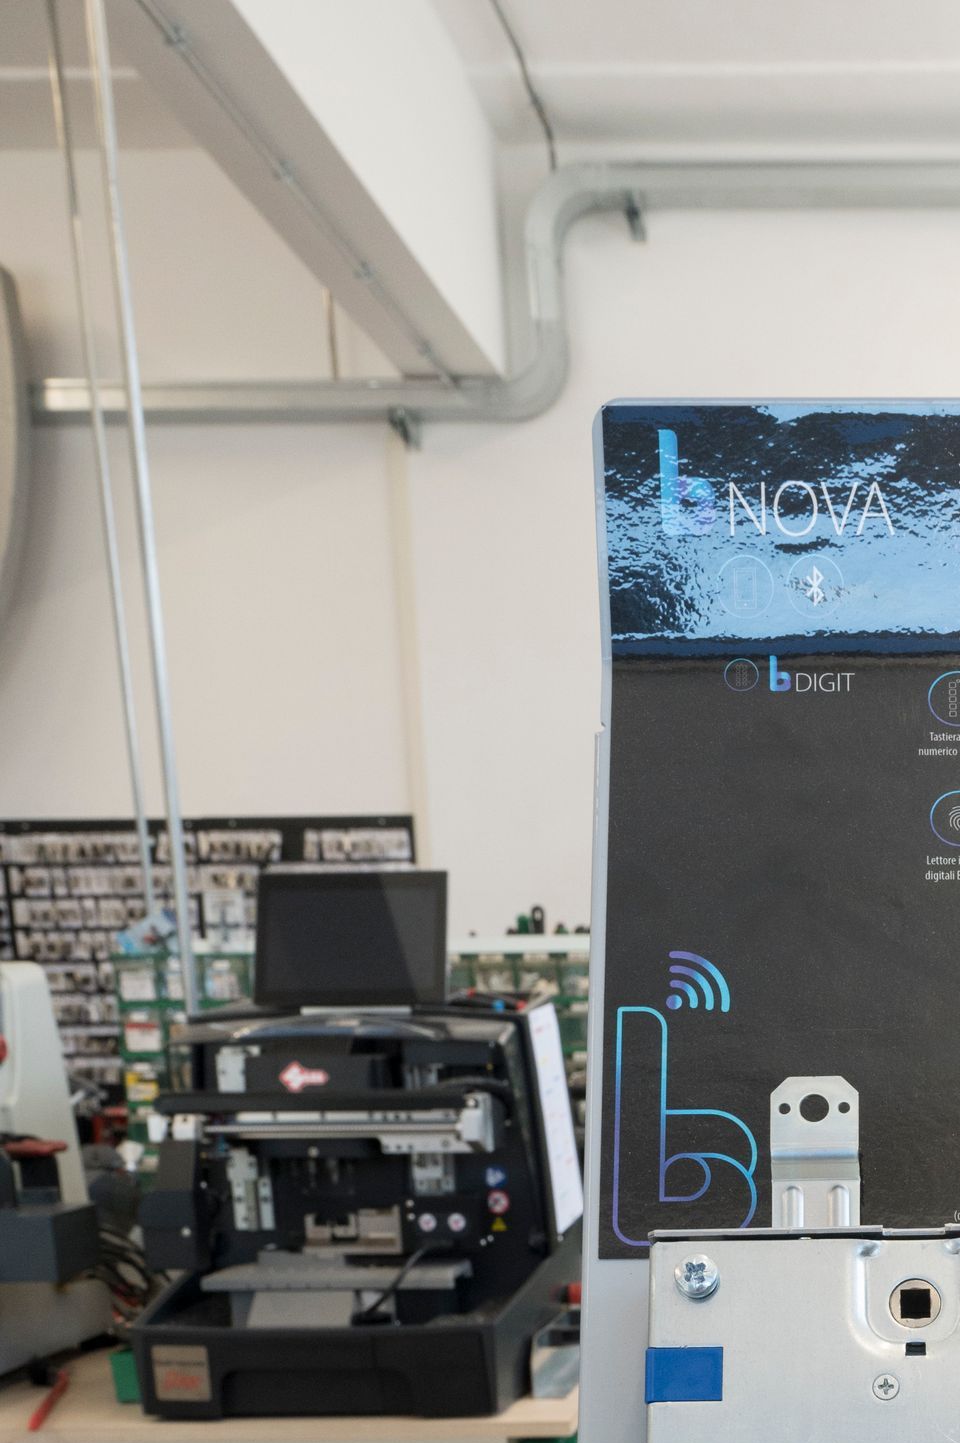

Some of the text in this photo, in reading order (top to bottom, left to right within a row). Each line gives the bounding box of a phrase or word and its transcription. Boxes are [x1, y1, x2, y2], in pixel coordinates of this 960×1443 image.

[729, 480, 895, 537] NOVA
[795, 672, 855, 692] DIGIT
[929, 732, 960, 742] Tastiera
[918, 746, 958, 757] numerico
[926, 855, 957, 866] Lettore
[925, 870, 956, 883] digitali
